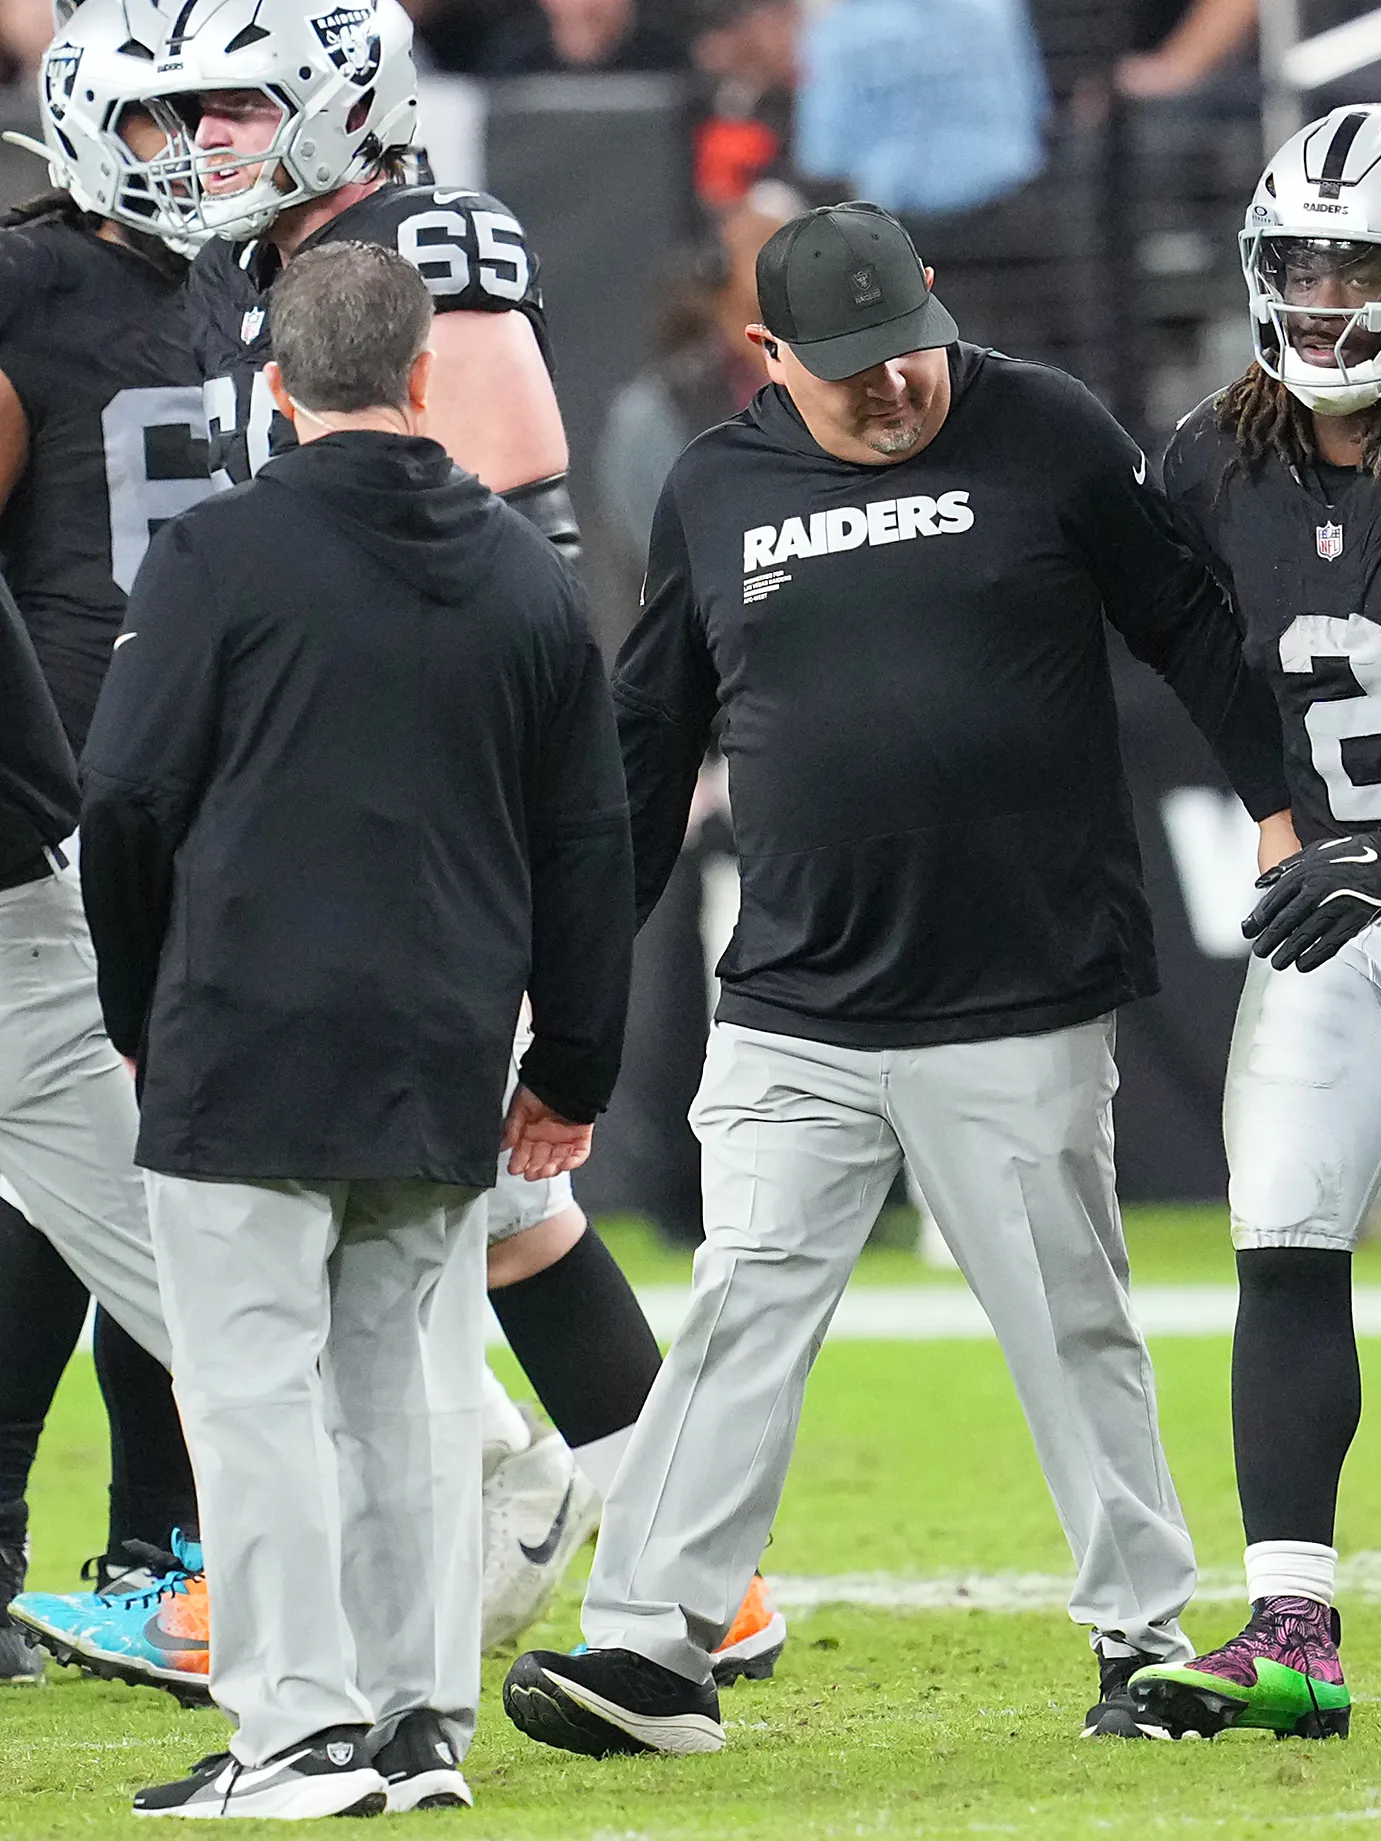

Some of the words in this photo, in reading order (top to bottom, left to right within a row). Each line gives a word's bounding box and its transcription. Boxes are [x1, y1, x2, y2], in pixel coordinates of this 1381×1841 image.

[1303, 202, 1349, 215] RAIDERS
[397, 210, 530, 302] 65
[743, 490, 975, 574] RAIDERS
[1320, 539, 1338, 554] NFL
